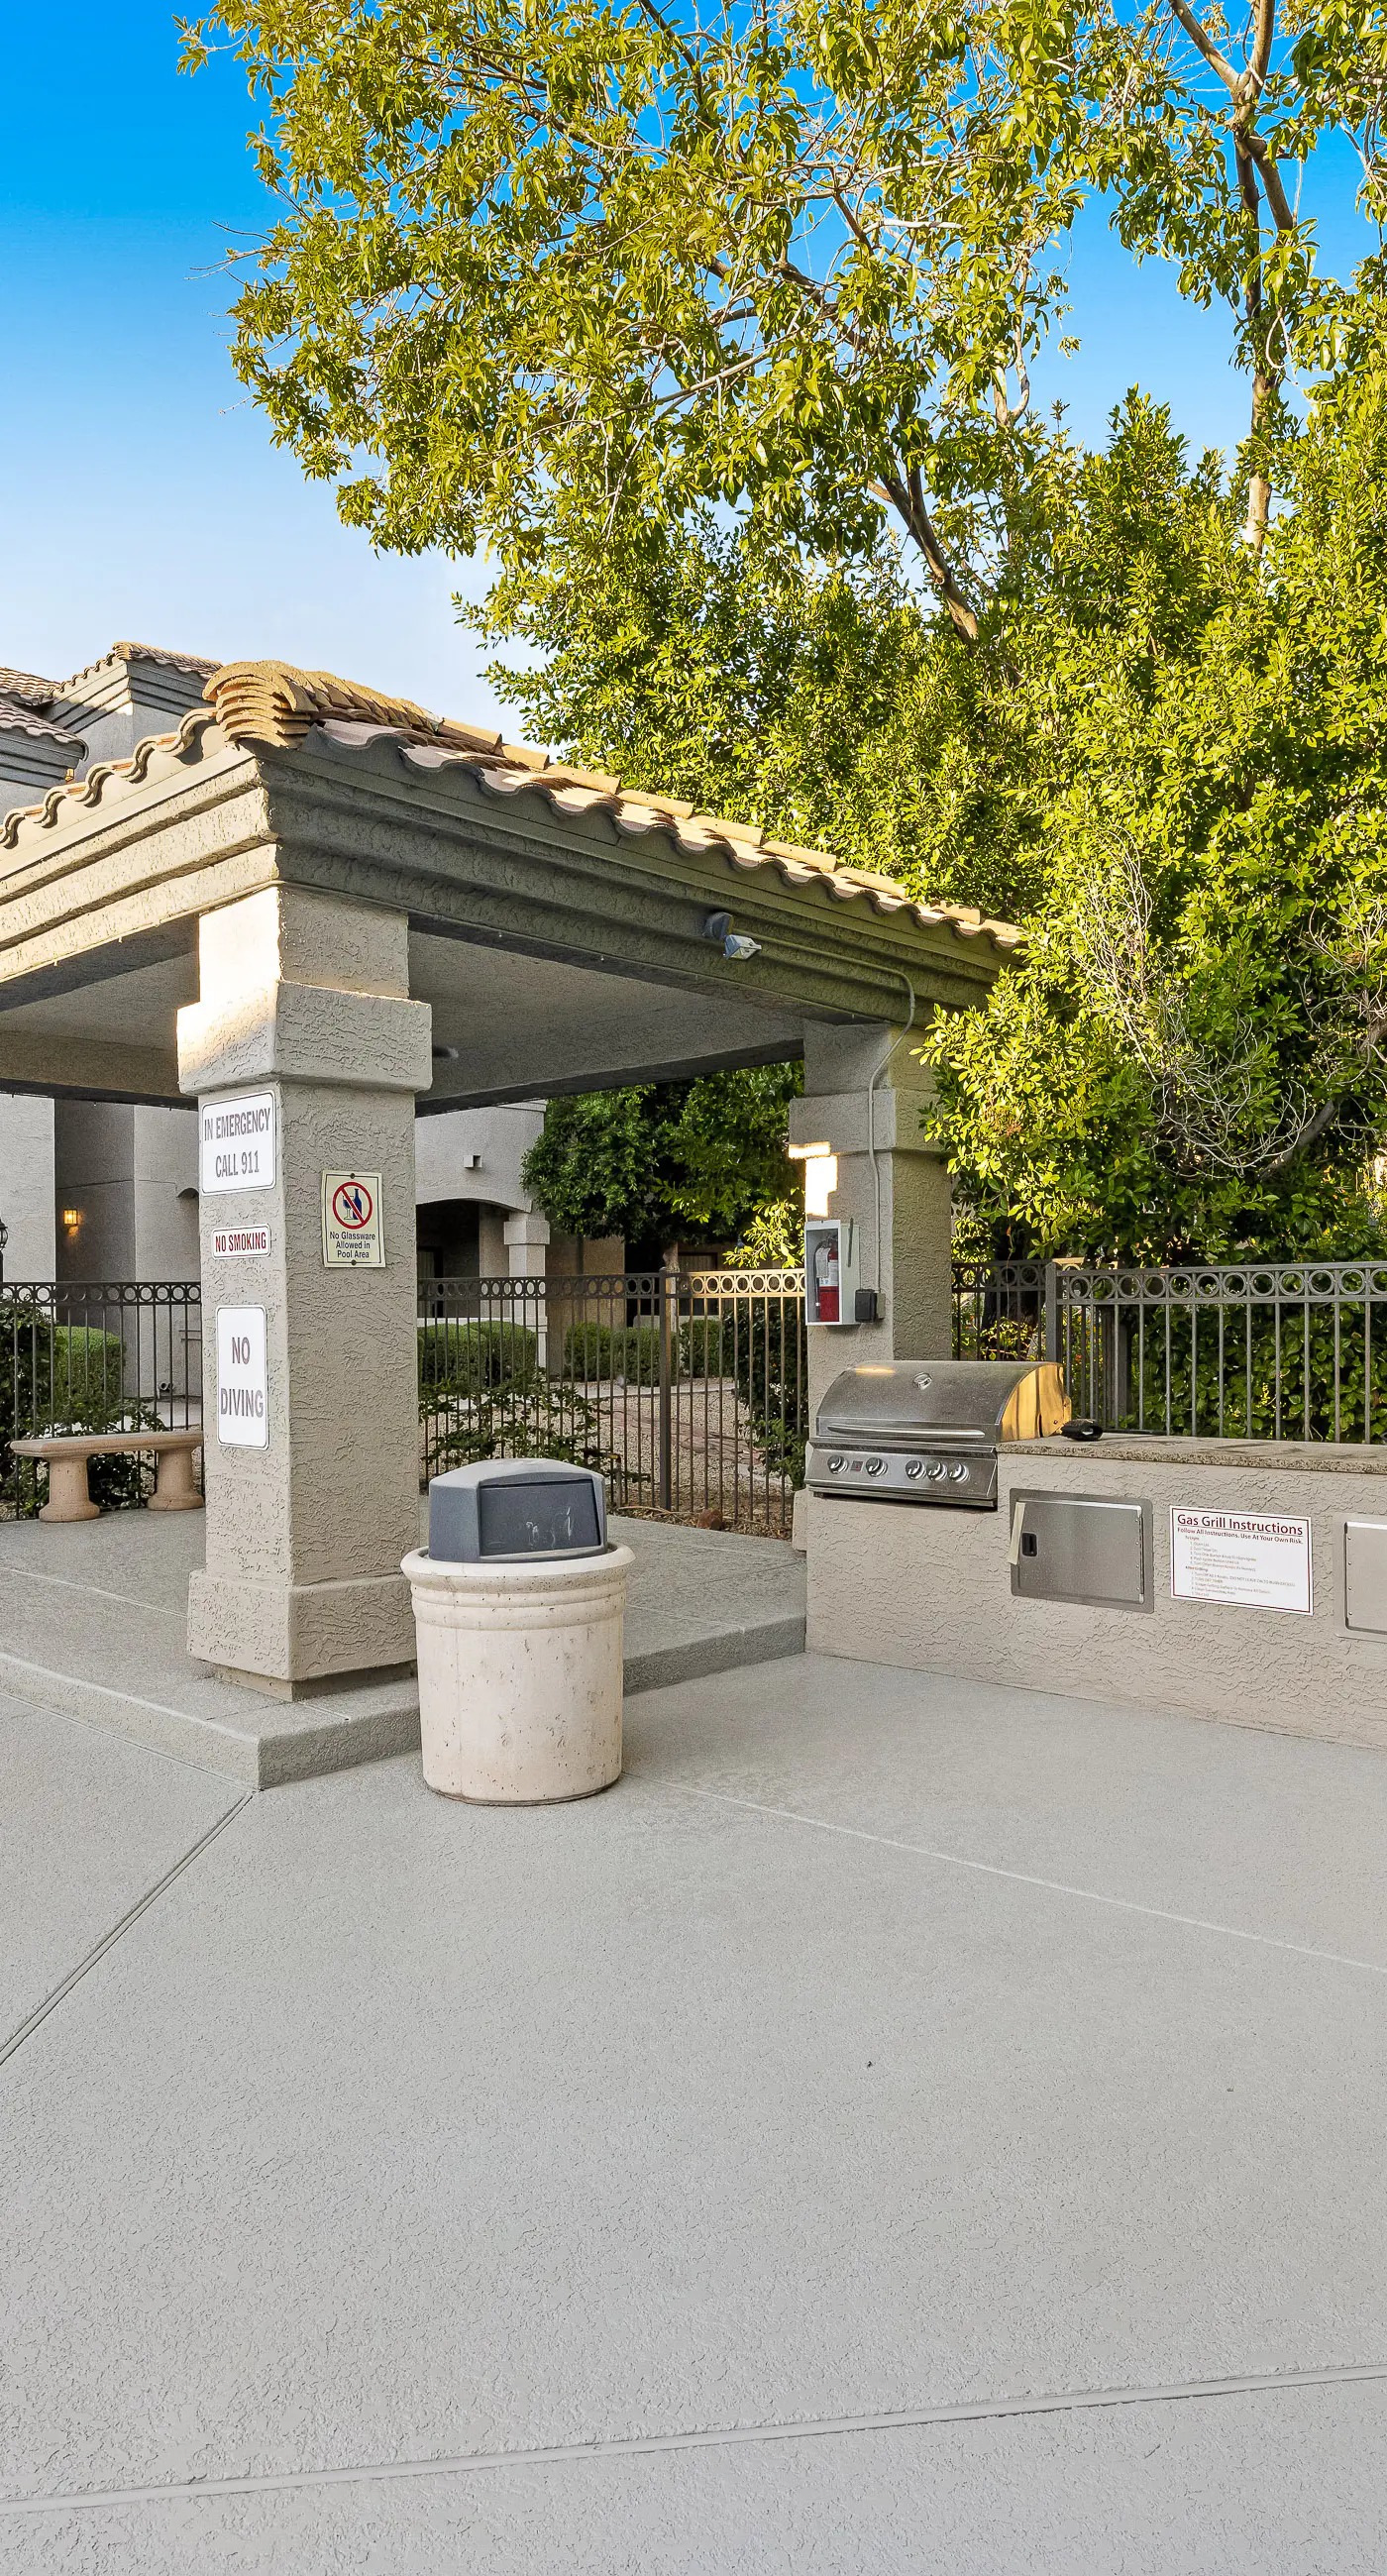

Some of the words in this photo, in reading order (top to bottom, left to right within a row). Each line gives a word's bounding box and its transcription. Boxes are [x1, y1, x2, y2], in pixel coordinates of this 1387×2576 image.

[204, 1118, 213, 1141] IN
[216, 1107, 270, 1139] EMERGENCY
[215, 1153, 239, 1178] CALL
[241, 1149, 260, 1175] 911
[215, 1234, 227, 1252] NO
[228, 1232, 267, 1251] SMOKING
[329, 1231, 340, 1239] No
[341, 1232, 375, 1240] Glassware
[336, 1240, 363, 1249] Allowed
[337, 1249, 353, 1258] Pool
[354, 1249, 370, 1258] Area
[232, 1337, 251, 1364] NO
[220, 1387, 264, 1418] DIVING
[1177, 1514, 1199, 1526] Gas
[1202, 1516, 1226, 1528] Grill
[1229, 1518, 1303, 1535] Instructions
